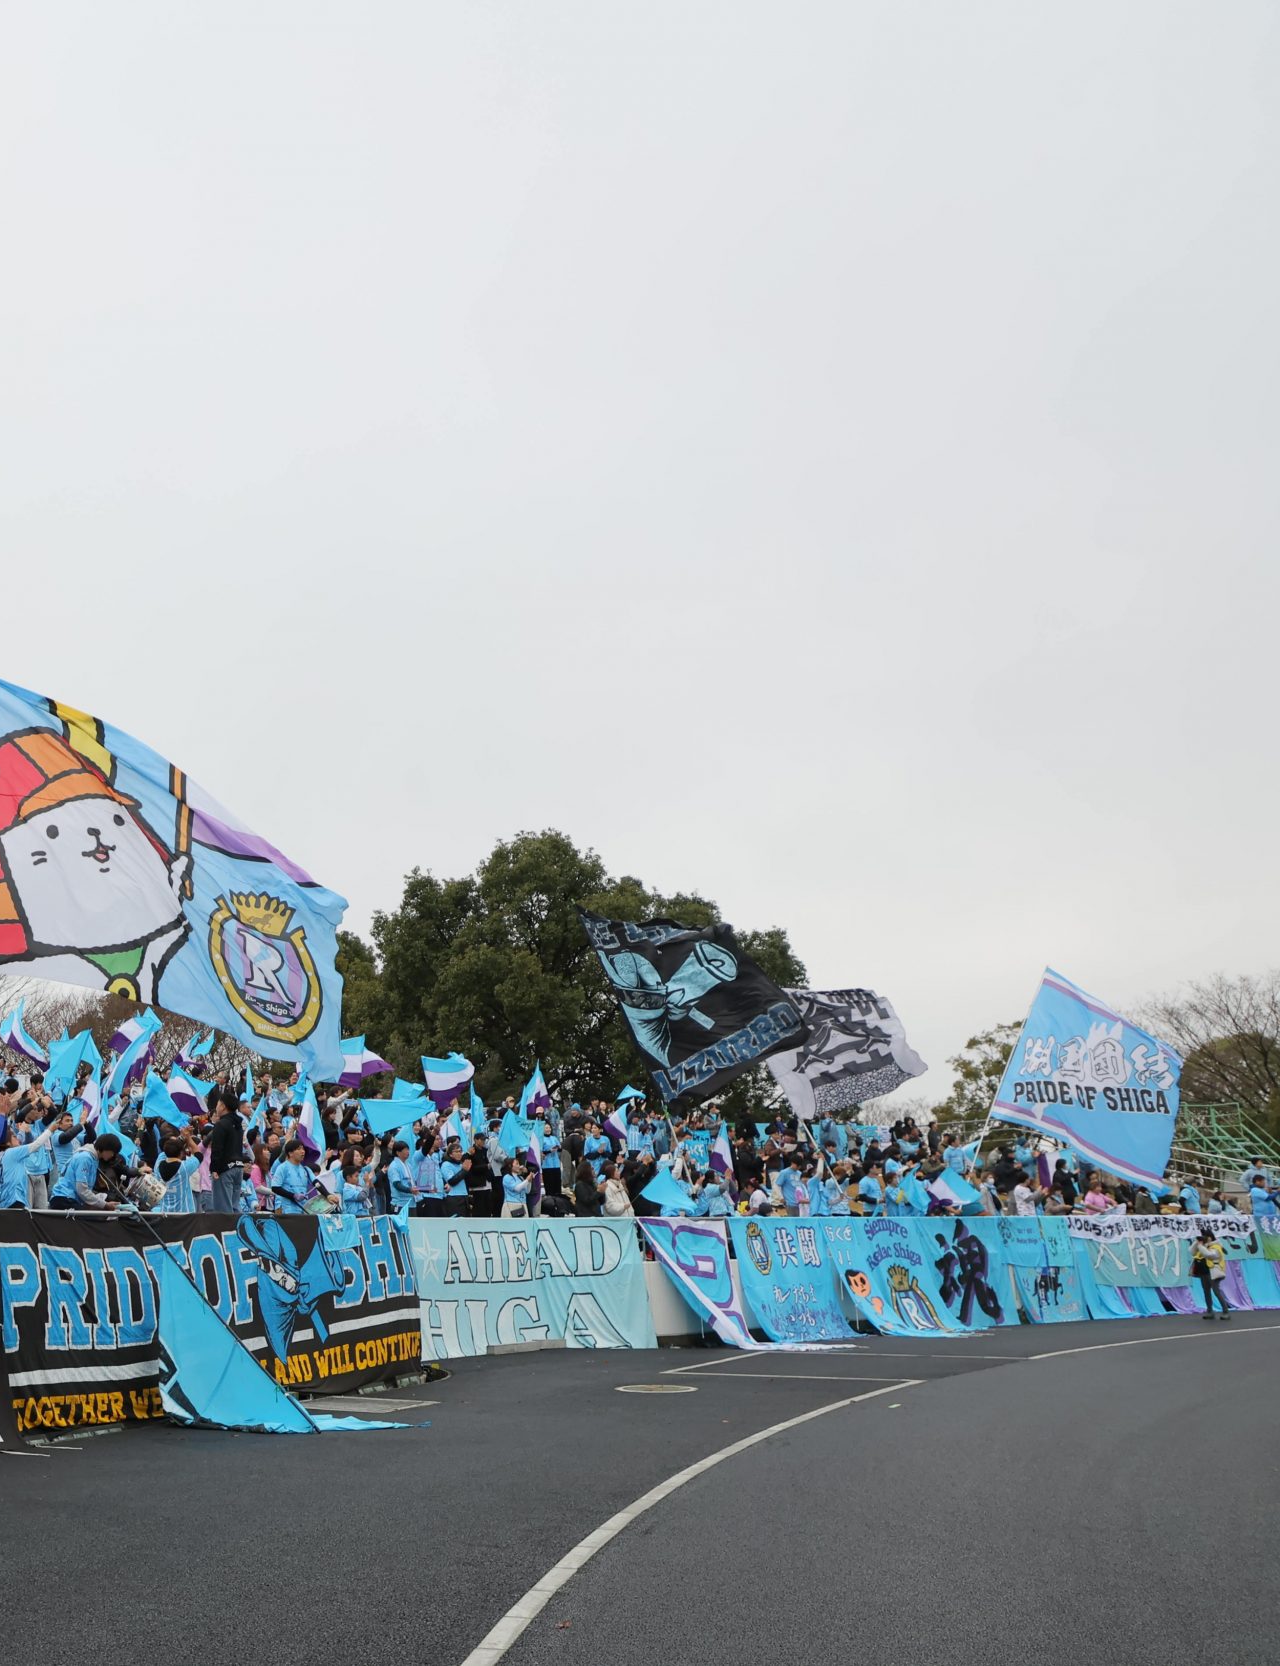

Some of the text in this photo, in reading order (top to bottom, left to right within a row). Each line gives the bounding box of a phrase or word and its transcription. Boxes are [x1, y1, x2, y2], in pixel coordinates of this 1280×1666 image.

[1014, 1080, 1171, 1115] PRIDE OF SHIGA
[444, 1226, 623, 1284] AHEAD
[894, 1242, 923, 1266] Shiga
[316, 1343, 355, 1378] WILL
[13, 1391, 126, 1432] TOGETHER
